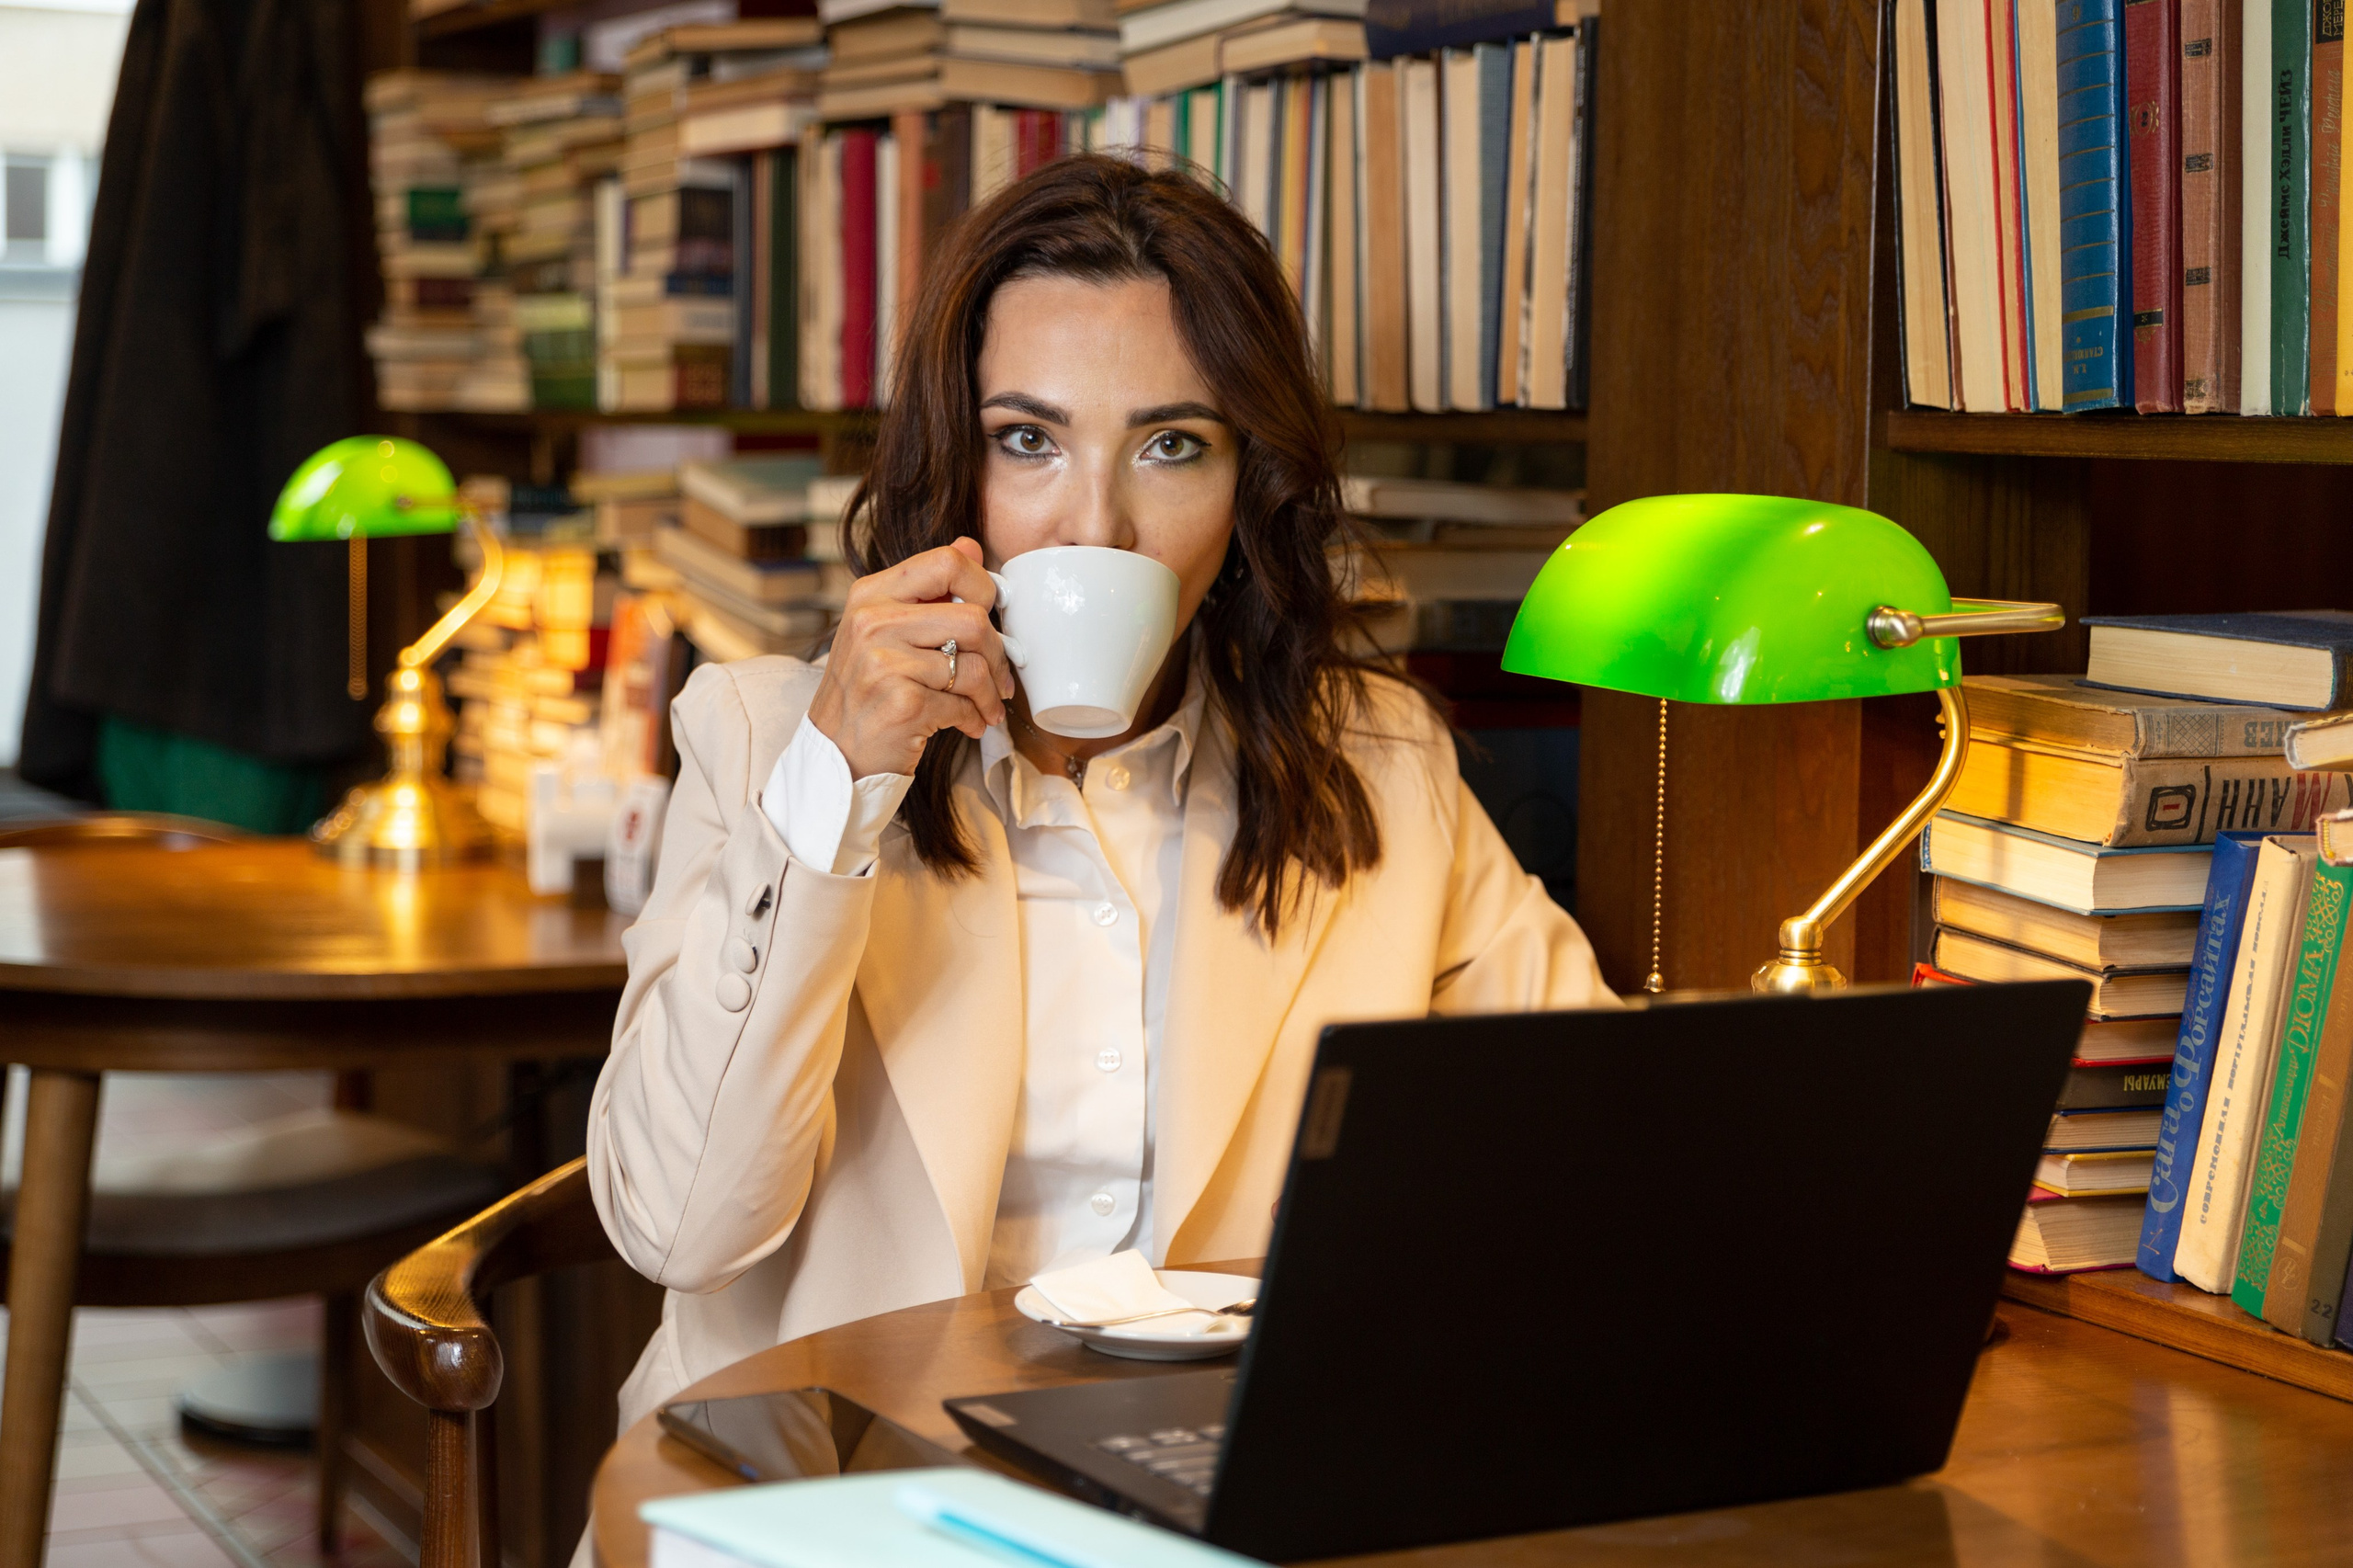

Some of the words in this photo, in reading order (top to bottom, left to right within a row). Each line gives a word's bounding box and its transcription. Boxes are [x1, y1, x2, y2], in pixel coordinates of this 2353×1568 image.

[2323, 0, 2332, 36] ДЖО
[2334, 0, 2343, 36] МЕРЕ
[2278, 69, 2292, 123] ЧЕЙЗ
[2279, 125, 2292, 181] Хэдли
[2278, 185, 2290, 260] Джеймс
[2150, 1104, 2181, 1213] Сага
[2174, 891, 2231, 1088] Форсайтах
[2122, 1074, 2171, 1092] ЕМУАРЫ
[2310, 1299, 2334, 1320] 22
